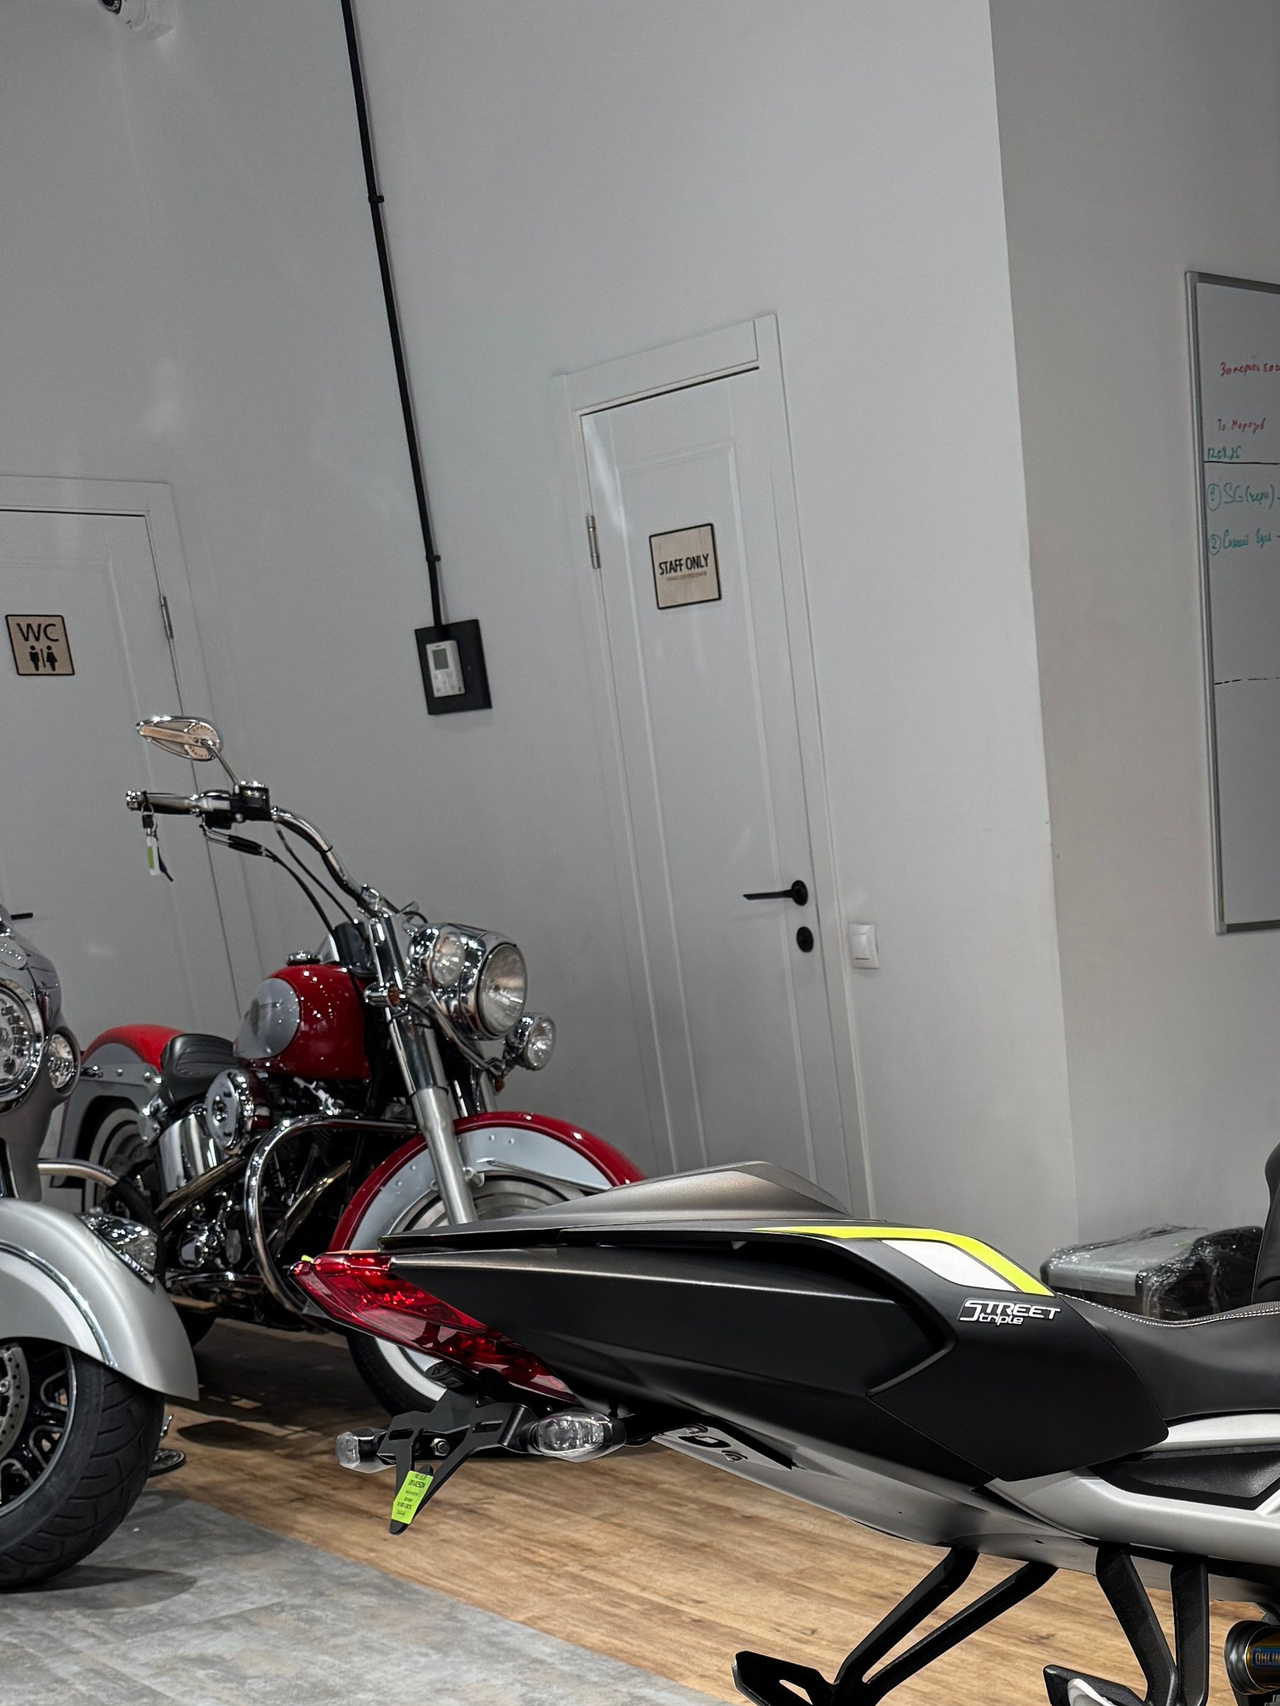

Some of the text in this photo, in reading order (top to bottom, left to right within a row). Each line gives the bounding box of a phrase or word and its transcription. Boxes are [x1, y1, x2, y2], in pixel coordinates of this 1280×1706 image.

[659, 553, 710, 576] STAFF ONLY
[16, 621, 60, 643] WC
